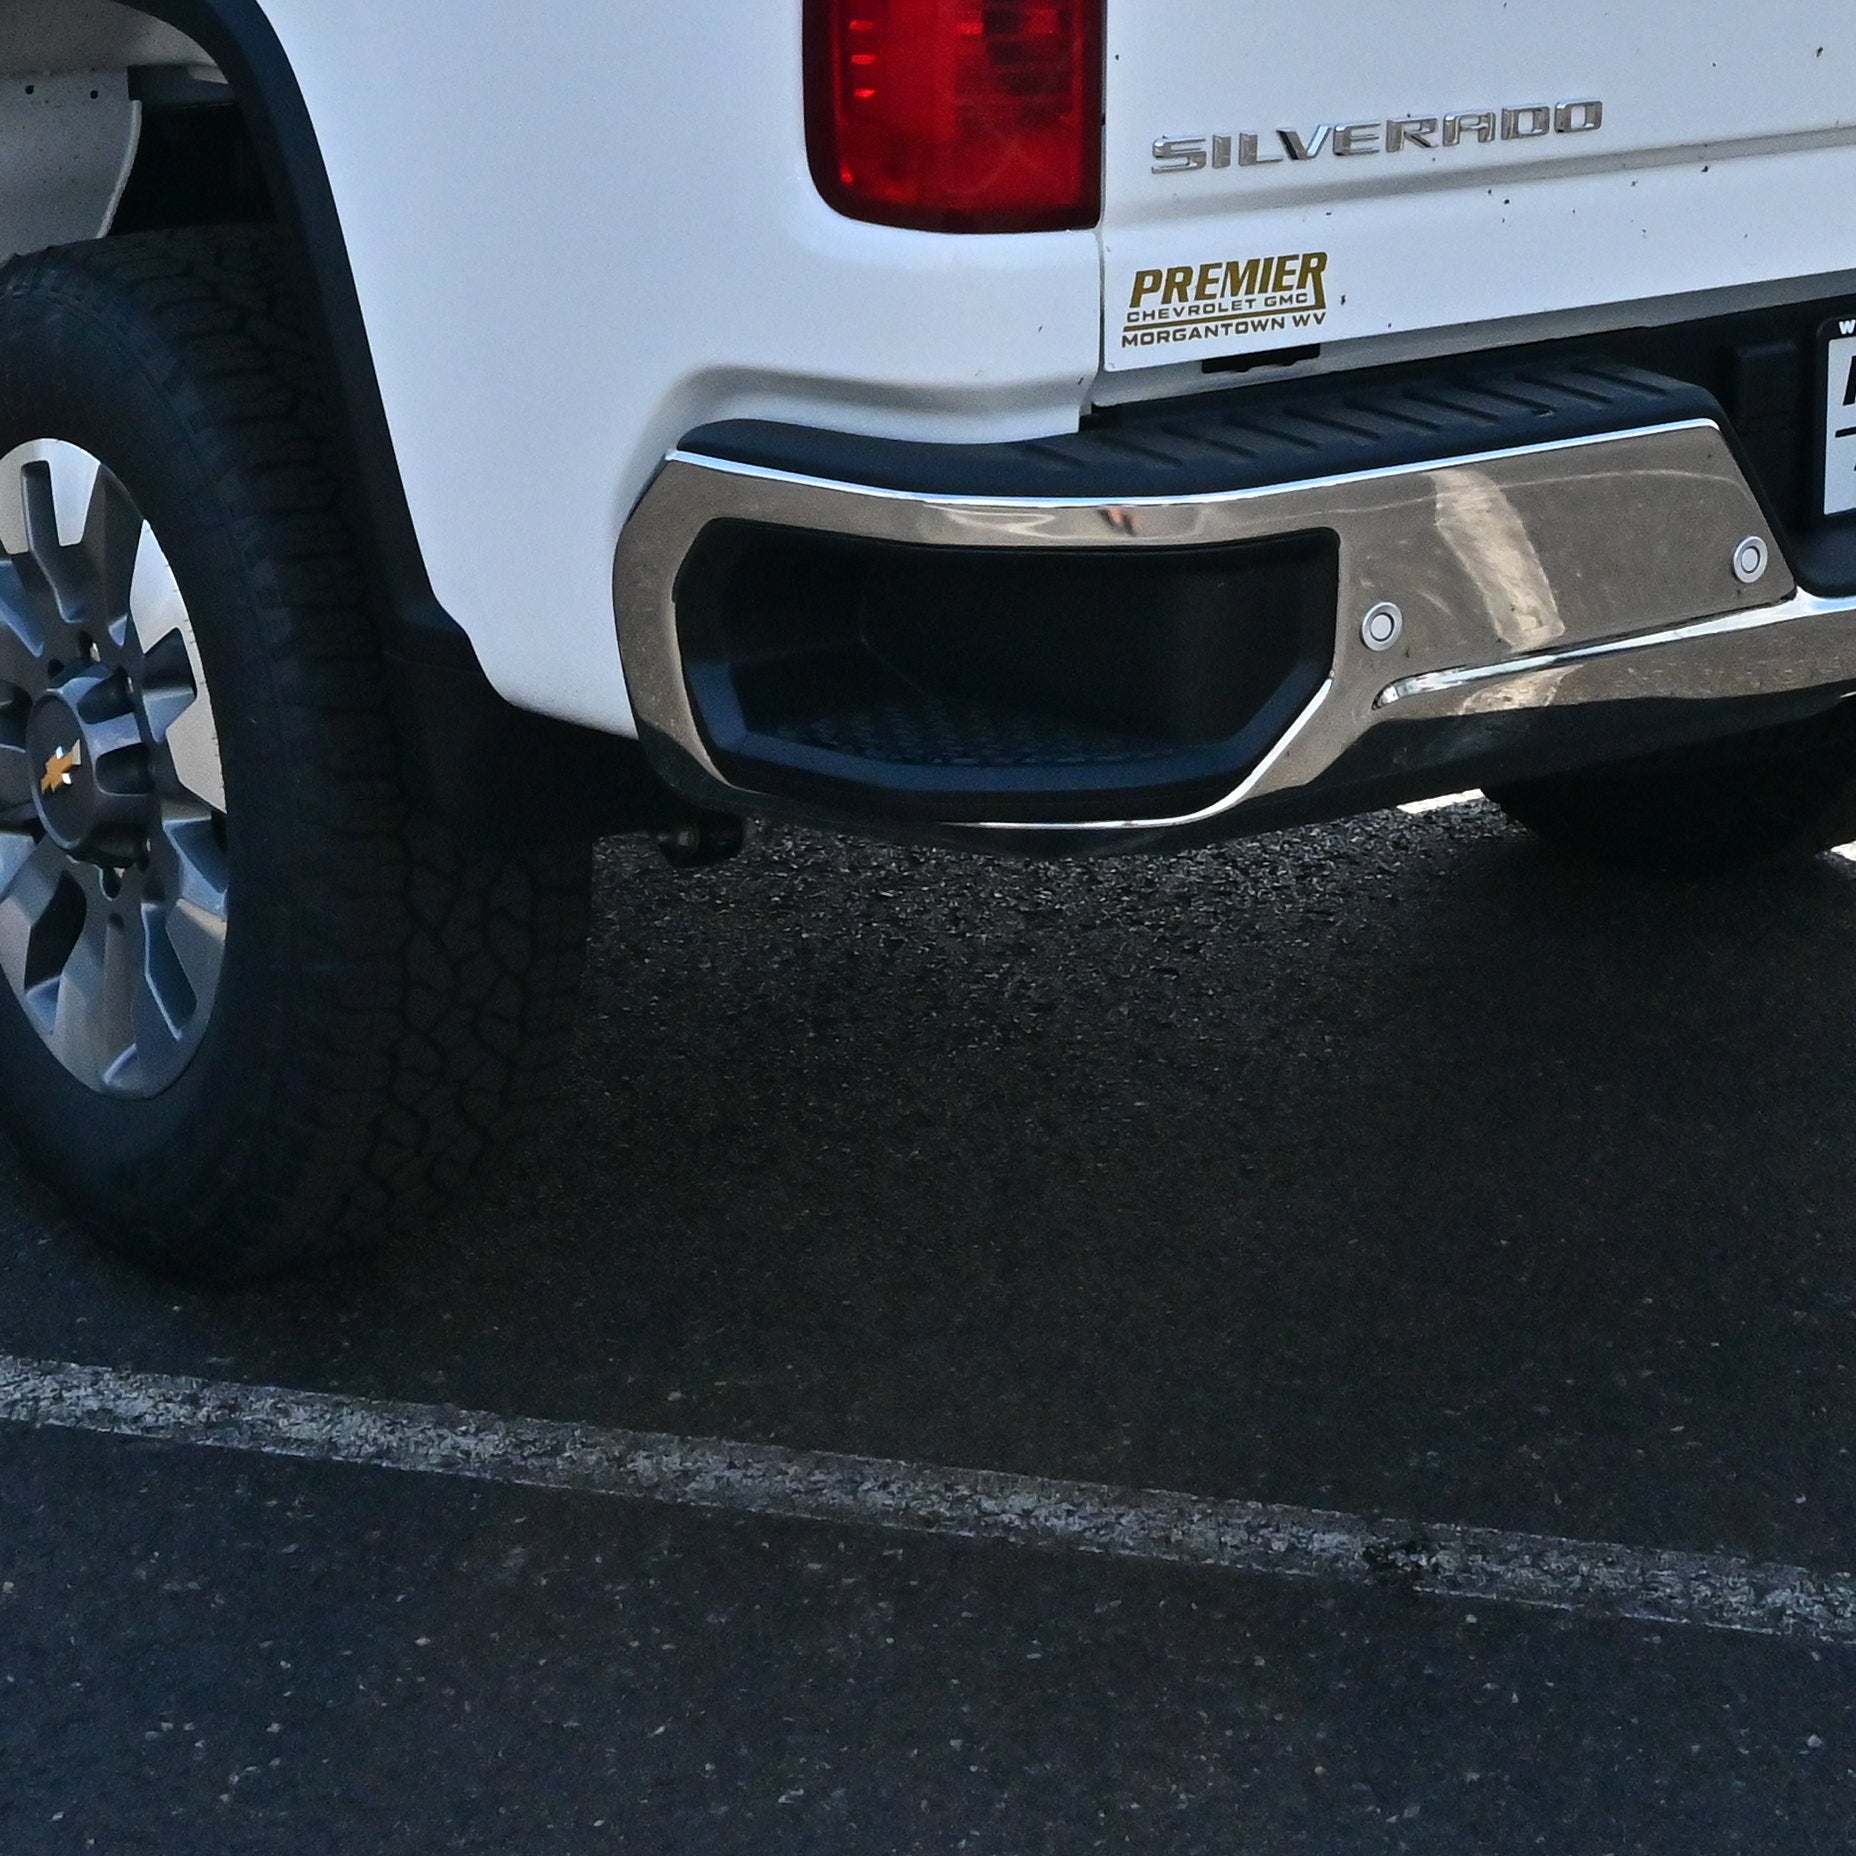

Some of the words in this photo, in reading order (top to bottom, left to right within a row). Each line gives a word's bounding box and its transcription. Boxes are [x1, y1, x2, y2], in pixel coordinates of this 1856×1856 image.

[1150, 99, 1604, 175] SILVERADO
[1129, 251, 1329, 309] PREMIER
[1121, 316, 1286, 348] MORGANTOWN
[1292, 311, 1327, 328] WV
[1126, 298, 1257, 323] CHEVROLET
[1263, 292, 1309, 308] GMC
